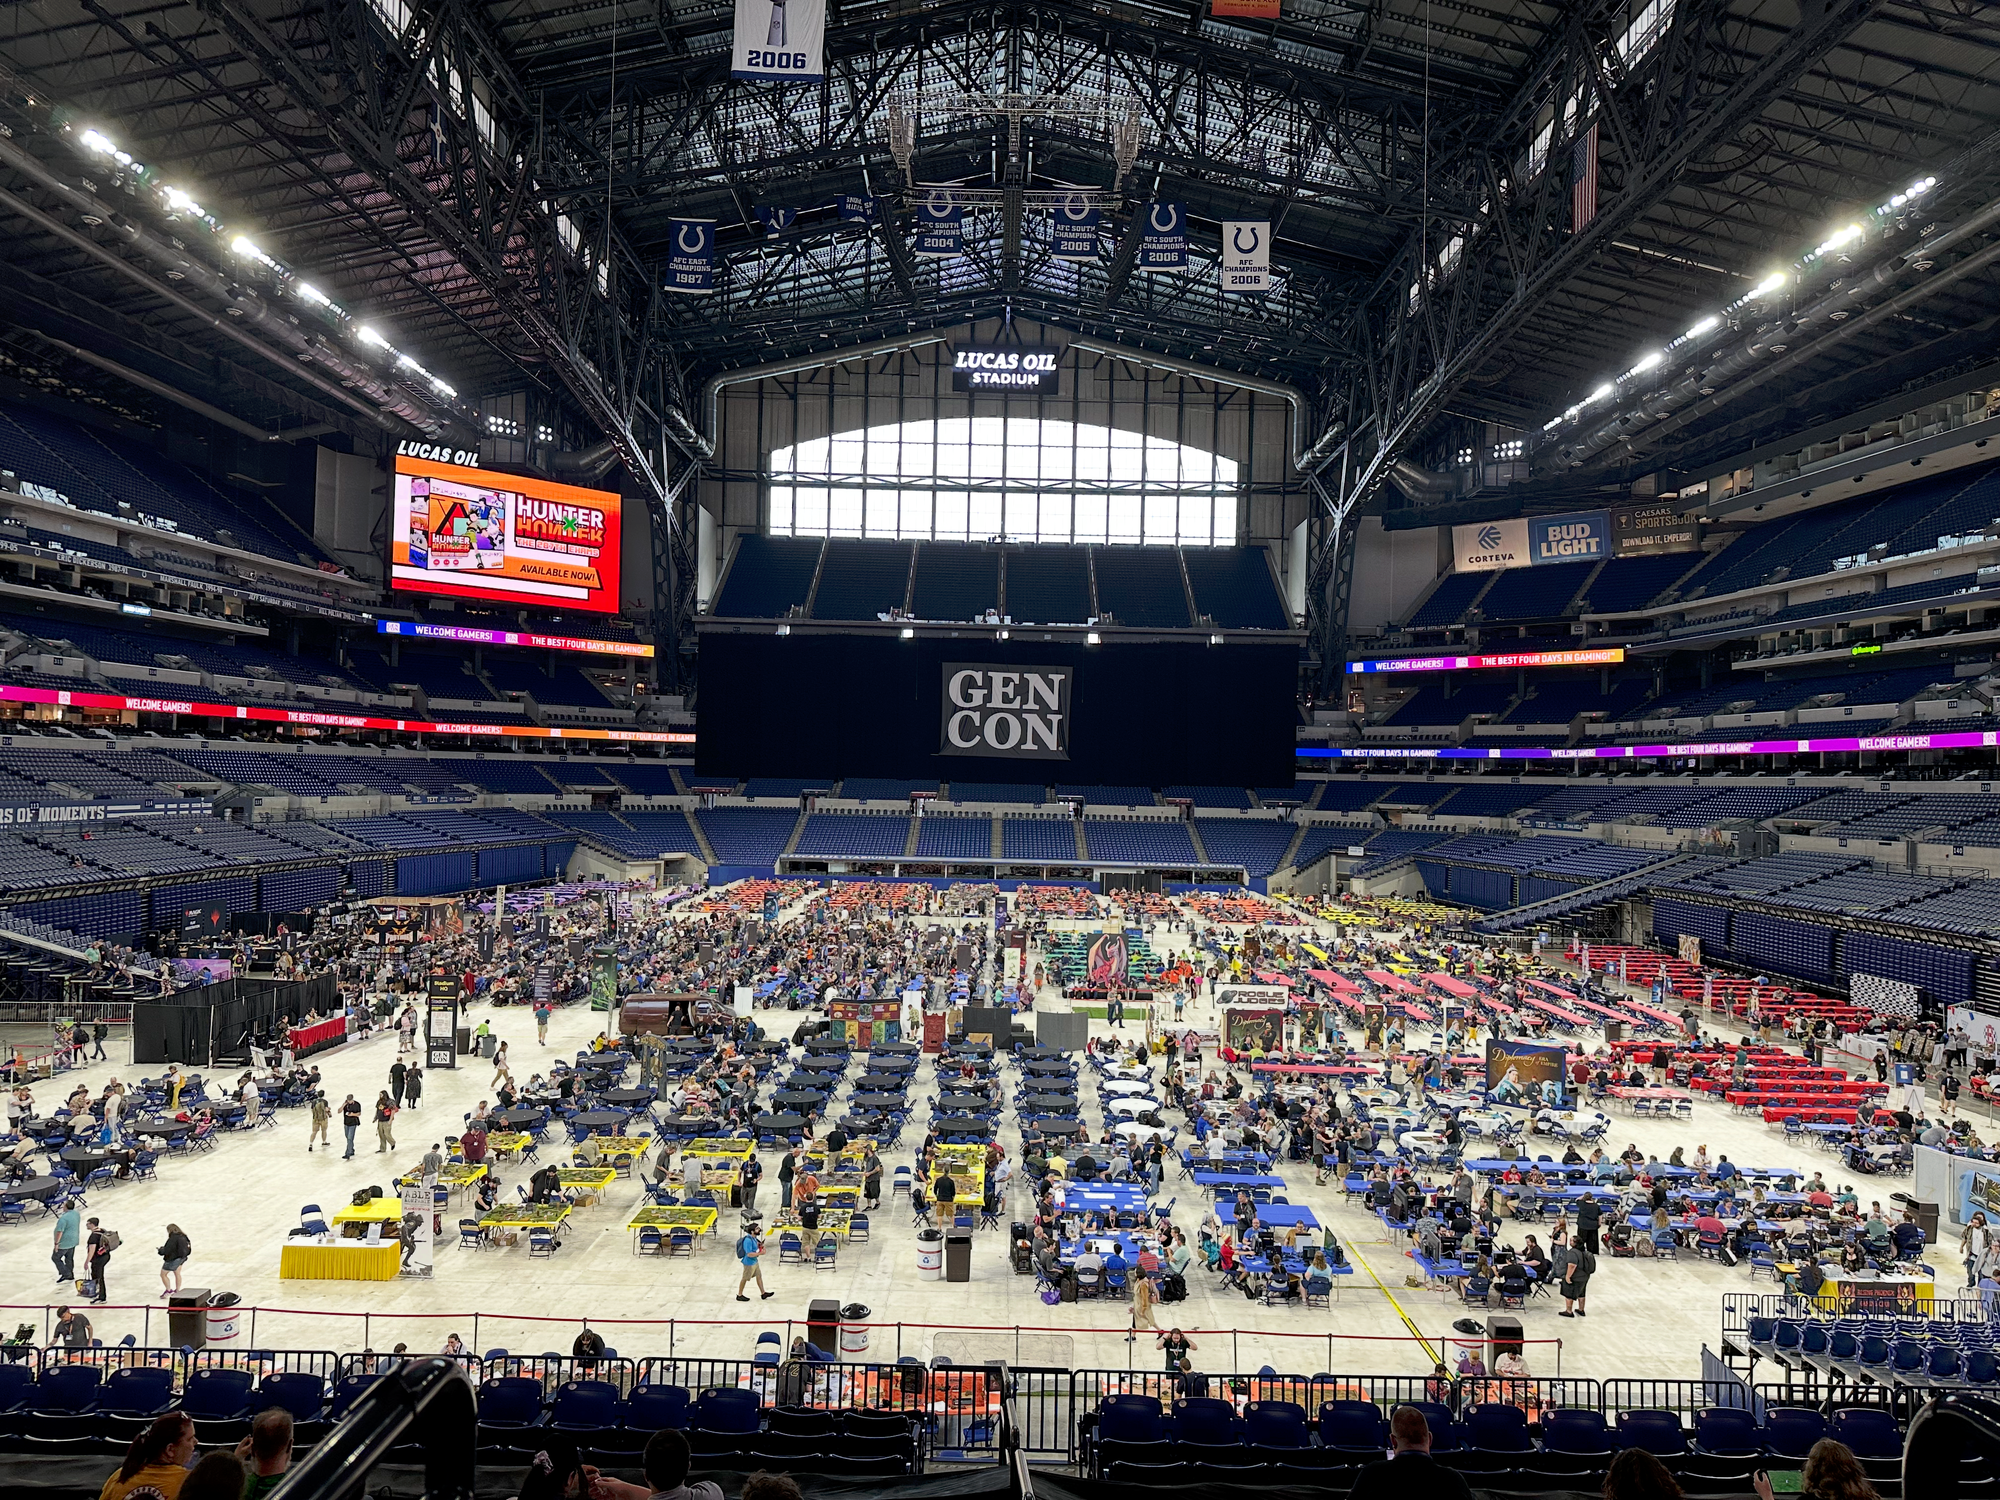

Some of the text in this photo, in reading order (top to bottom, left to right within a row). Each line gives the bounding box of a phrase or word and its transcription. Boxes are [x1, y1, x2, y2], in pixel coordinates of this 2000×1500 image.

[747, 49, 806, 69] 2006
[1055, 231, 1096, 239] CHAMPIONS
[924, 238, 954, 247] 2004
[1061, 241, 1090, 251] 2005
[1149, 252, 1178, 261] 2006
[669, 263, 711, 272] CHAMPIONS
[675, 273, 702, 284] 1987
[1231, 275, 1260, 284] 2006
[955, 352, 1057, 371] LUCAS OIL
[972, 372, 1039, 385] STADIUM
[397, 440, 479, 467] LUCAS OIL
[517, 495, 604, 528] HUNTER
[1635, 508, 1671, 518] CAESARS
[1636, 513, 1697, 529] SPORTSBOOK
[1547, 524, 1591, 542] BUD
[1622, 536, 1654, 547] DOWNLOAD
[1663, 532, 1693, 544] EMPEROR!
[516, 537, 535, 548] THE
[1541, 538, 1598, 557] LIGHT
[57, 553, 72, 563] ERIC
[73, 555, 106, 570] DICKERSON
[1468, 553, 1515, 564] CORTEVA
[520, 565, 595, 582] AVAILABLE NOW!
[160, 575, 187, 587] MARSHALL
[415, 625, 493, 641] WELCOME GAMERS!
[531, 636, 546, 645] THE
[547, 638, 565, 647] BEST
[567, 640, 586, 649] FOUR
[587, 641, 605, 651] DAYS
[606, 643, 613, 651] IN
[1375, 660, 1444, 670] WELCOME GAMERS!
[1481, 657, 1496, 665] THE
[1497, 656, 1518, 665] BEST
[1519, 655, 1540, 664] FOUR
[1541, 654, 1562, 663] DAYS
[1563, 653, 1573, 662] IN
[948, 669, 1066, 710] GEN
[126, 698, 192, 713] WELCOME GAMERS!
[288, 712, 344, 725] THE BEST FOUR DAYS IN
[436, 724, 503, 735] WELCOME GAMERS!
[608, 731, 619, 739] THE
[620, 732, 636, 740] BEST
[637, 732, 652, 740] FOUR
[653, 733, 668, 741] DAYS
[947, 710, 1060, 750] CON
[1667, 744, 1726, 754] THE BEST FOUR DAYS IN
[1859, 736, 1930, 749] WELCOME GAMERS!
[38, 806, 105, 821] MOMENTS
[1232, 1013, 1267, 1030] Diplomacy
[1492, 1047, 1535, 1067] Diplomacy
[404, 1191, 430, 1199] ABLE
